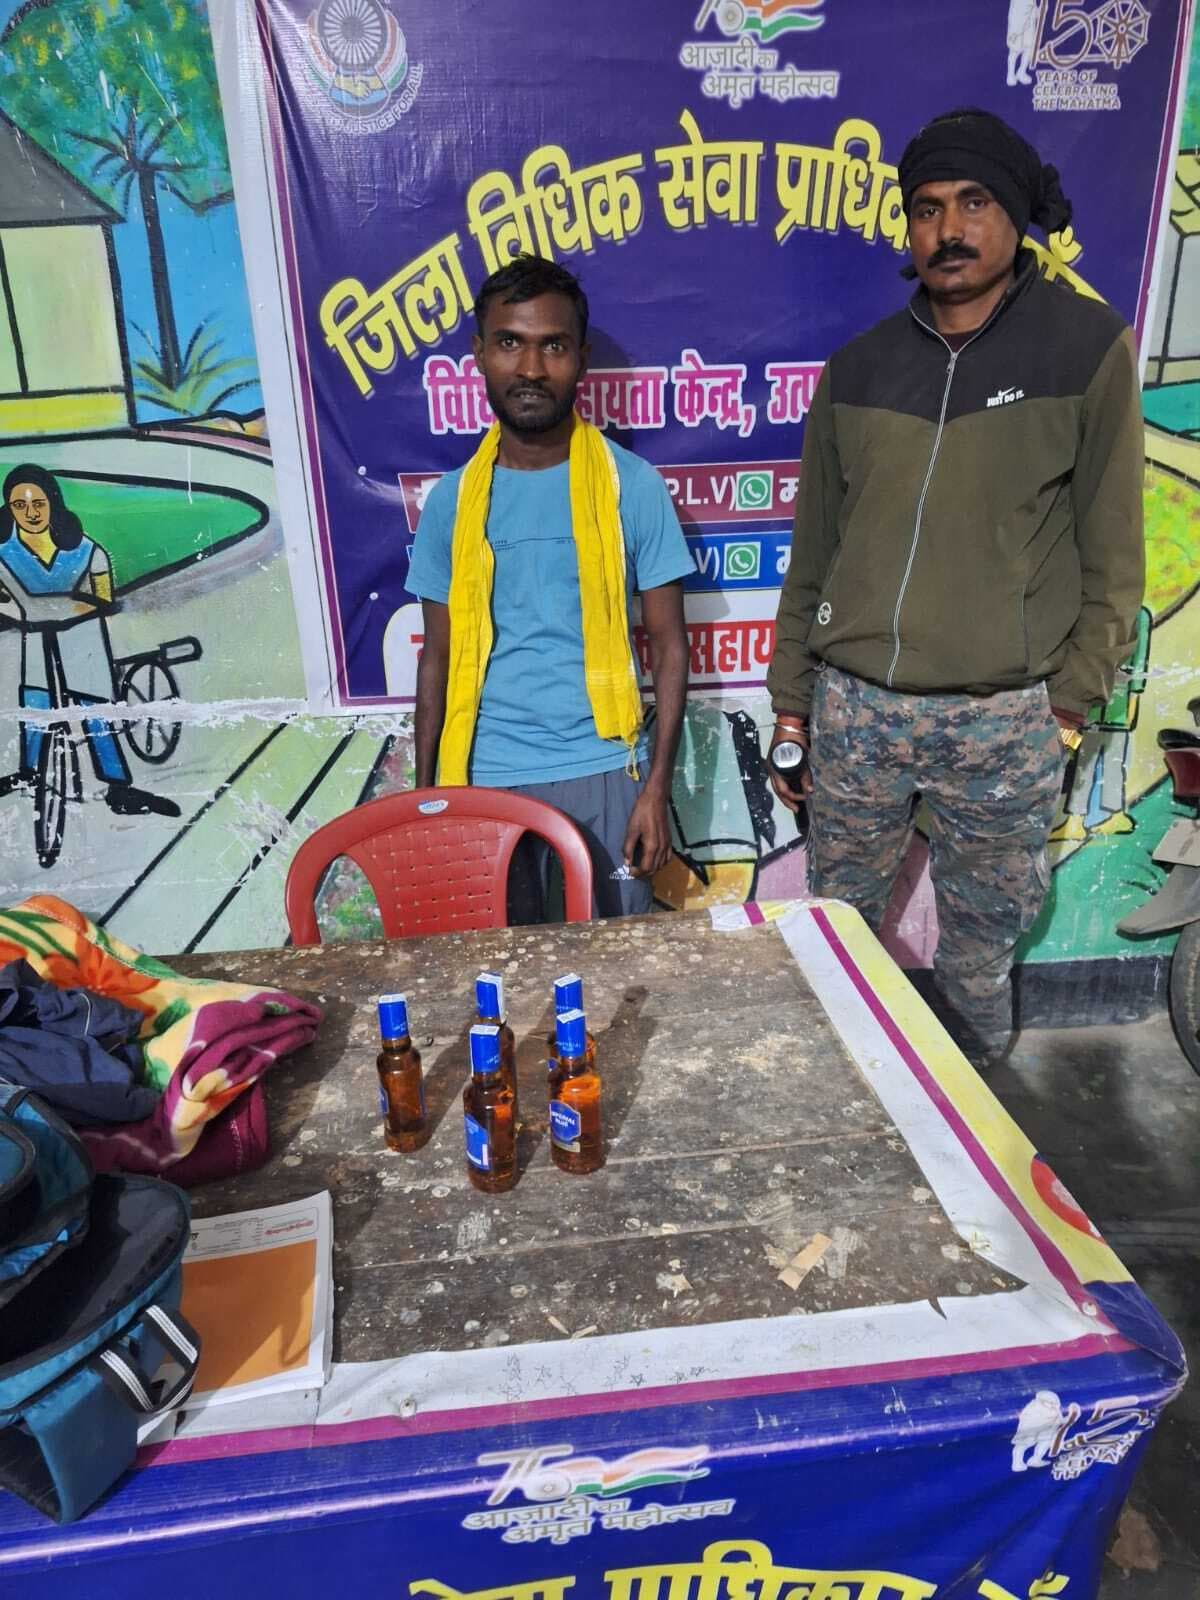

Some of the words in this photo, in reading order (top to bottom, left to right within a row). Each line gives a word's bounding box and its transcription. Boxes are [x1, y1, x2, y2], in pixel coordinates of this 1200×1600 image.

[758, 50, 779, 68] का
[1036, 70, 1076, 83] YEARS
[1079, 69, 1097, 83] OF
[701, 71, 756, 109] अमृत
[759, 64, 840, 102] महोत्सव
[1033, 84, 1118, 98] CELEBRATING
[345, 111, 397, 134] JUSTICE
[391, 89, 416, 119] FOR
[1033, 98, 1057, 110] THE
[1060, 98, 1121, 110] MAHATMA
[319, 232, 476, 397] जिला
[467, 144, 645, 276] विधिक
[655, 109, 763, 230] सेवा
[573, 366, 668, 430] हायता
[671, 348, 757, 438] केन्द्र,
[986, 396, 1004, 408] JUST
[1004, 393, 1015, 403] DO
[594, 1498, 631, 1514] का
[502, 1518, 595, 1544] अमृत
[601, 1499, 736, 1531] महोत्सव
